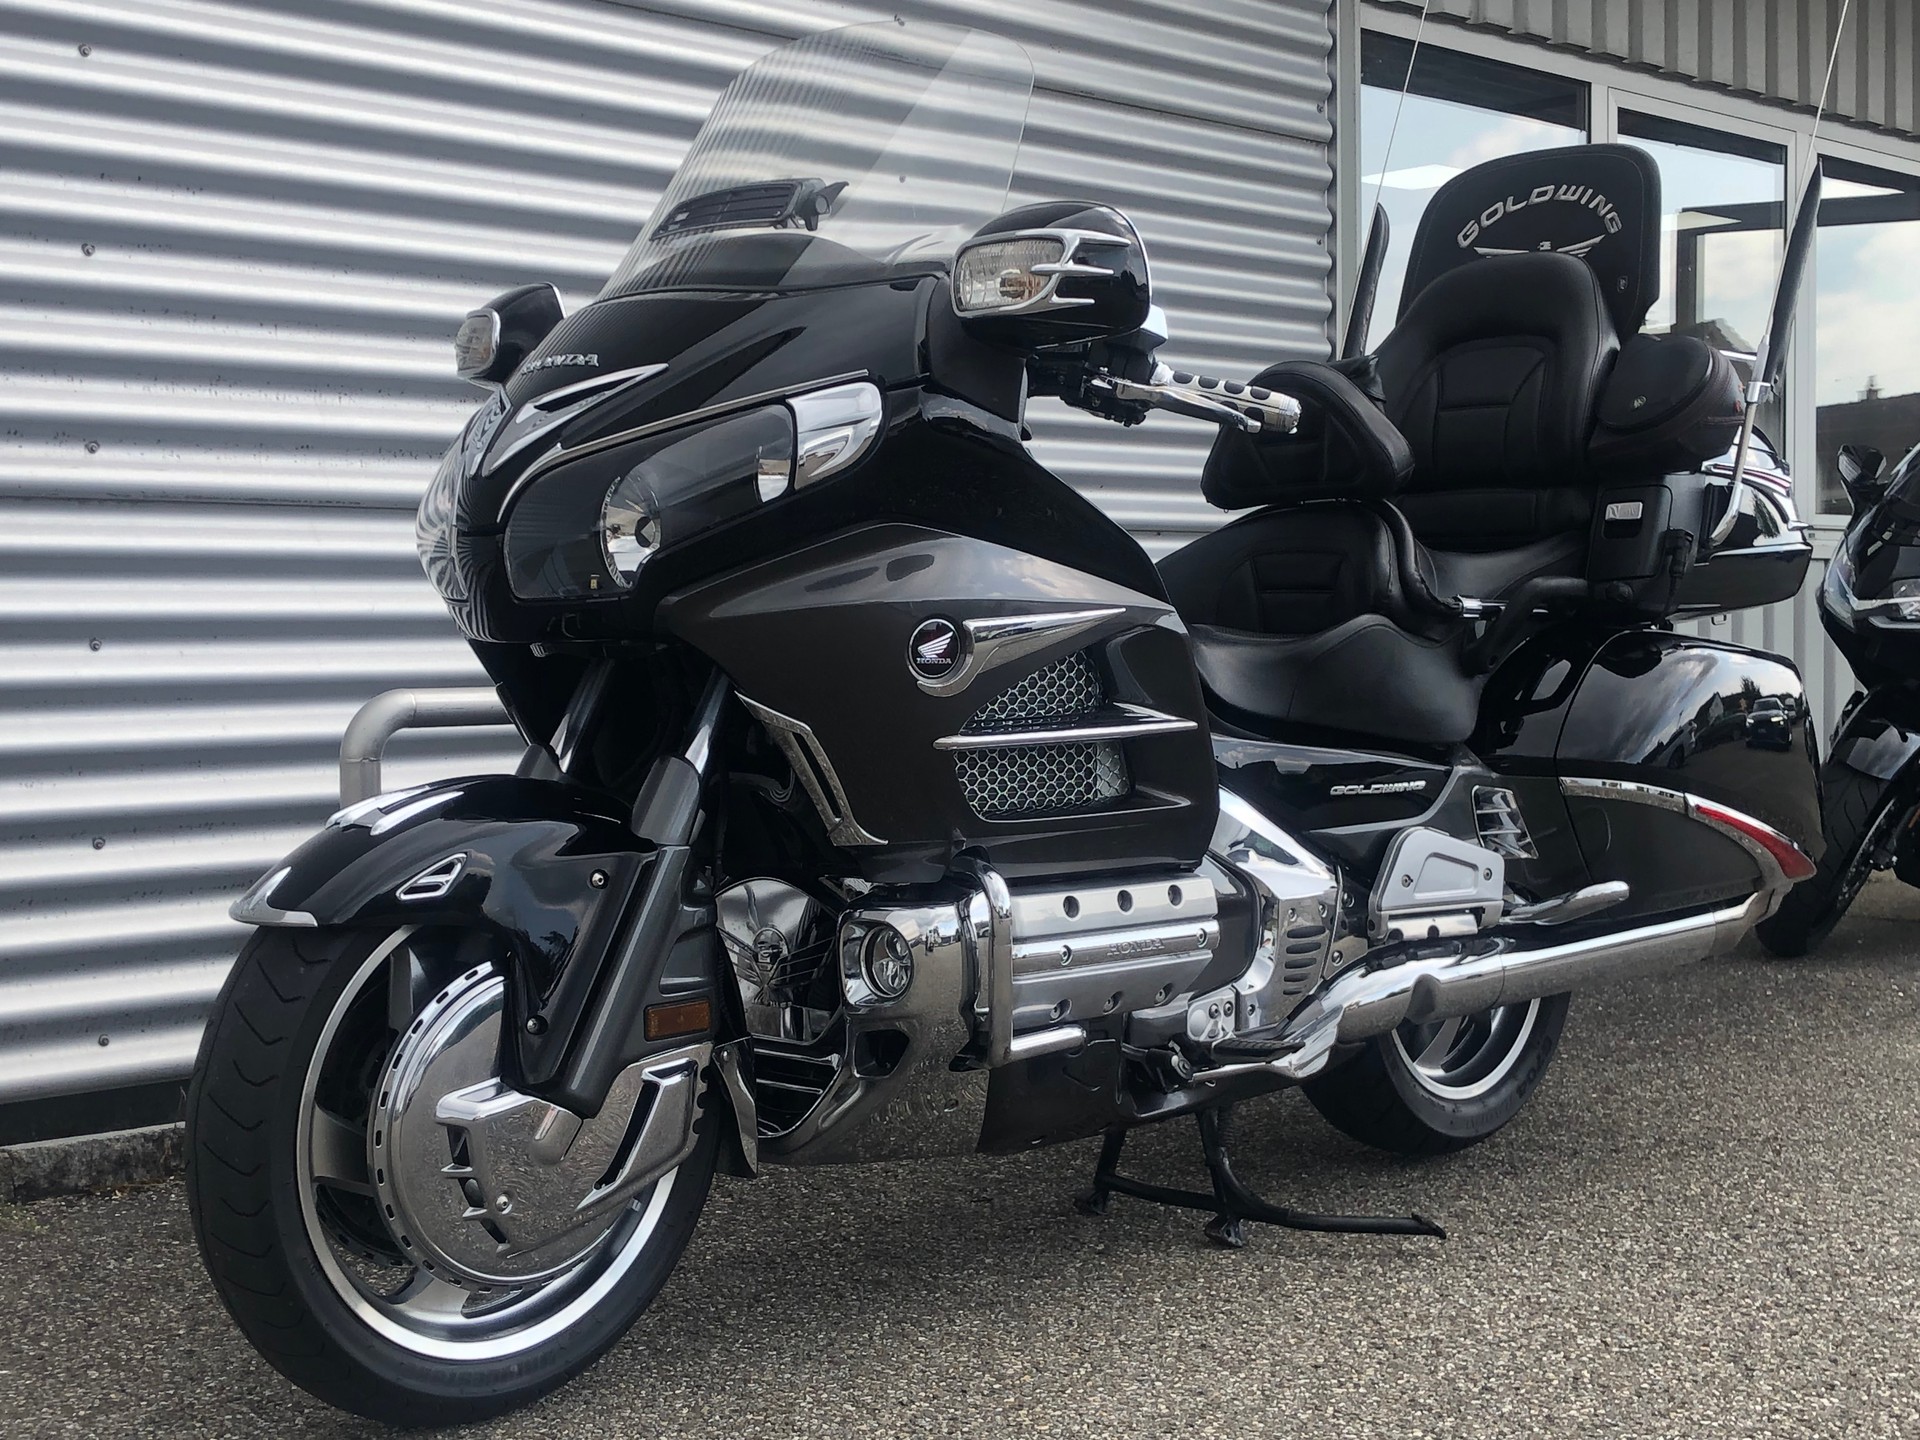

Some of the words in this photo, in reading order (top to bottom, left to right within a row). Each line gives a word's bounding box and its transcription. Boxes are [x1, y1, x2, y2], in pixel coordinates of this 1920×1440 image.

[1456, 184, 1623, 248] GOLDWING
[1330, 780, 1426, 796] GOLDWING
[1106, 937, 1165, 956] HONDA
